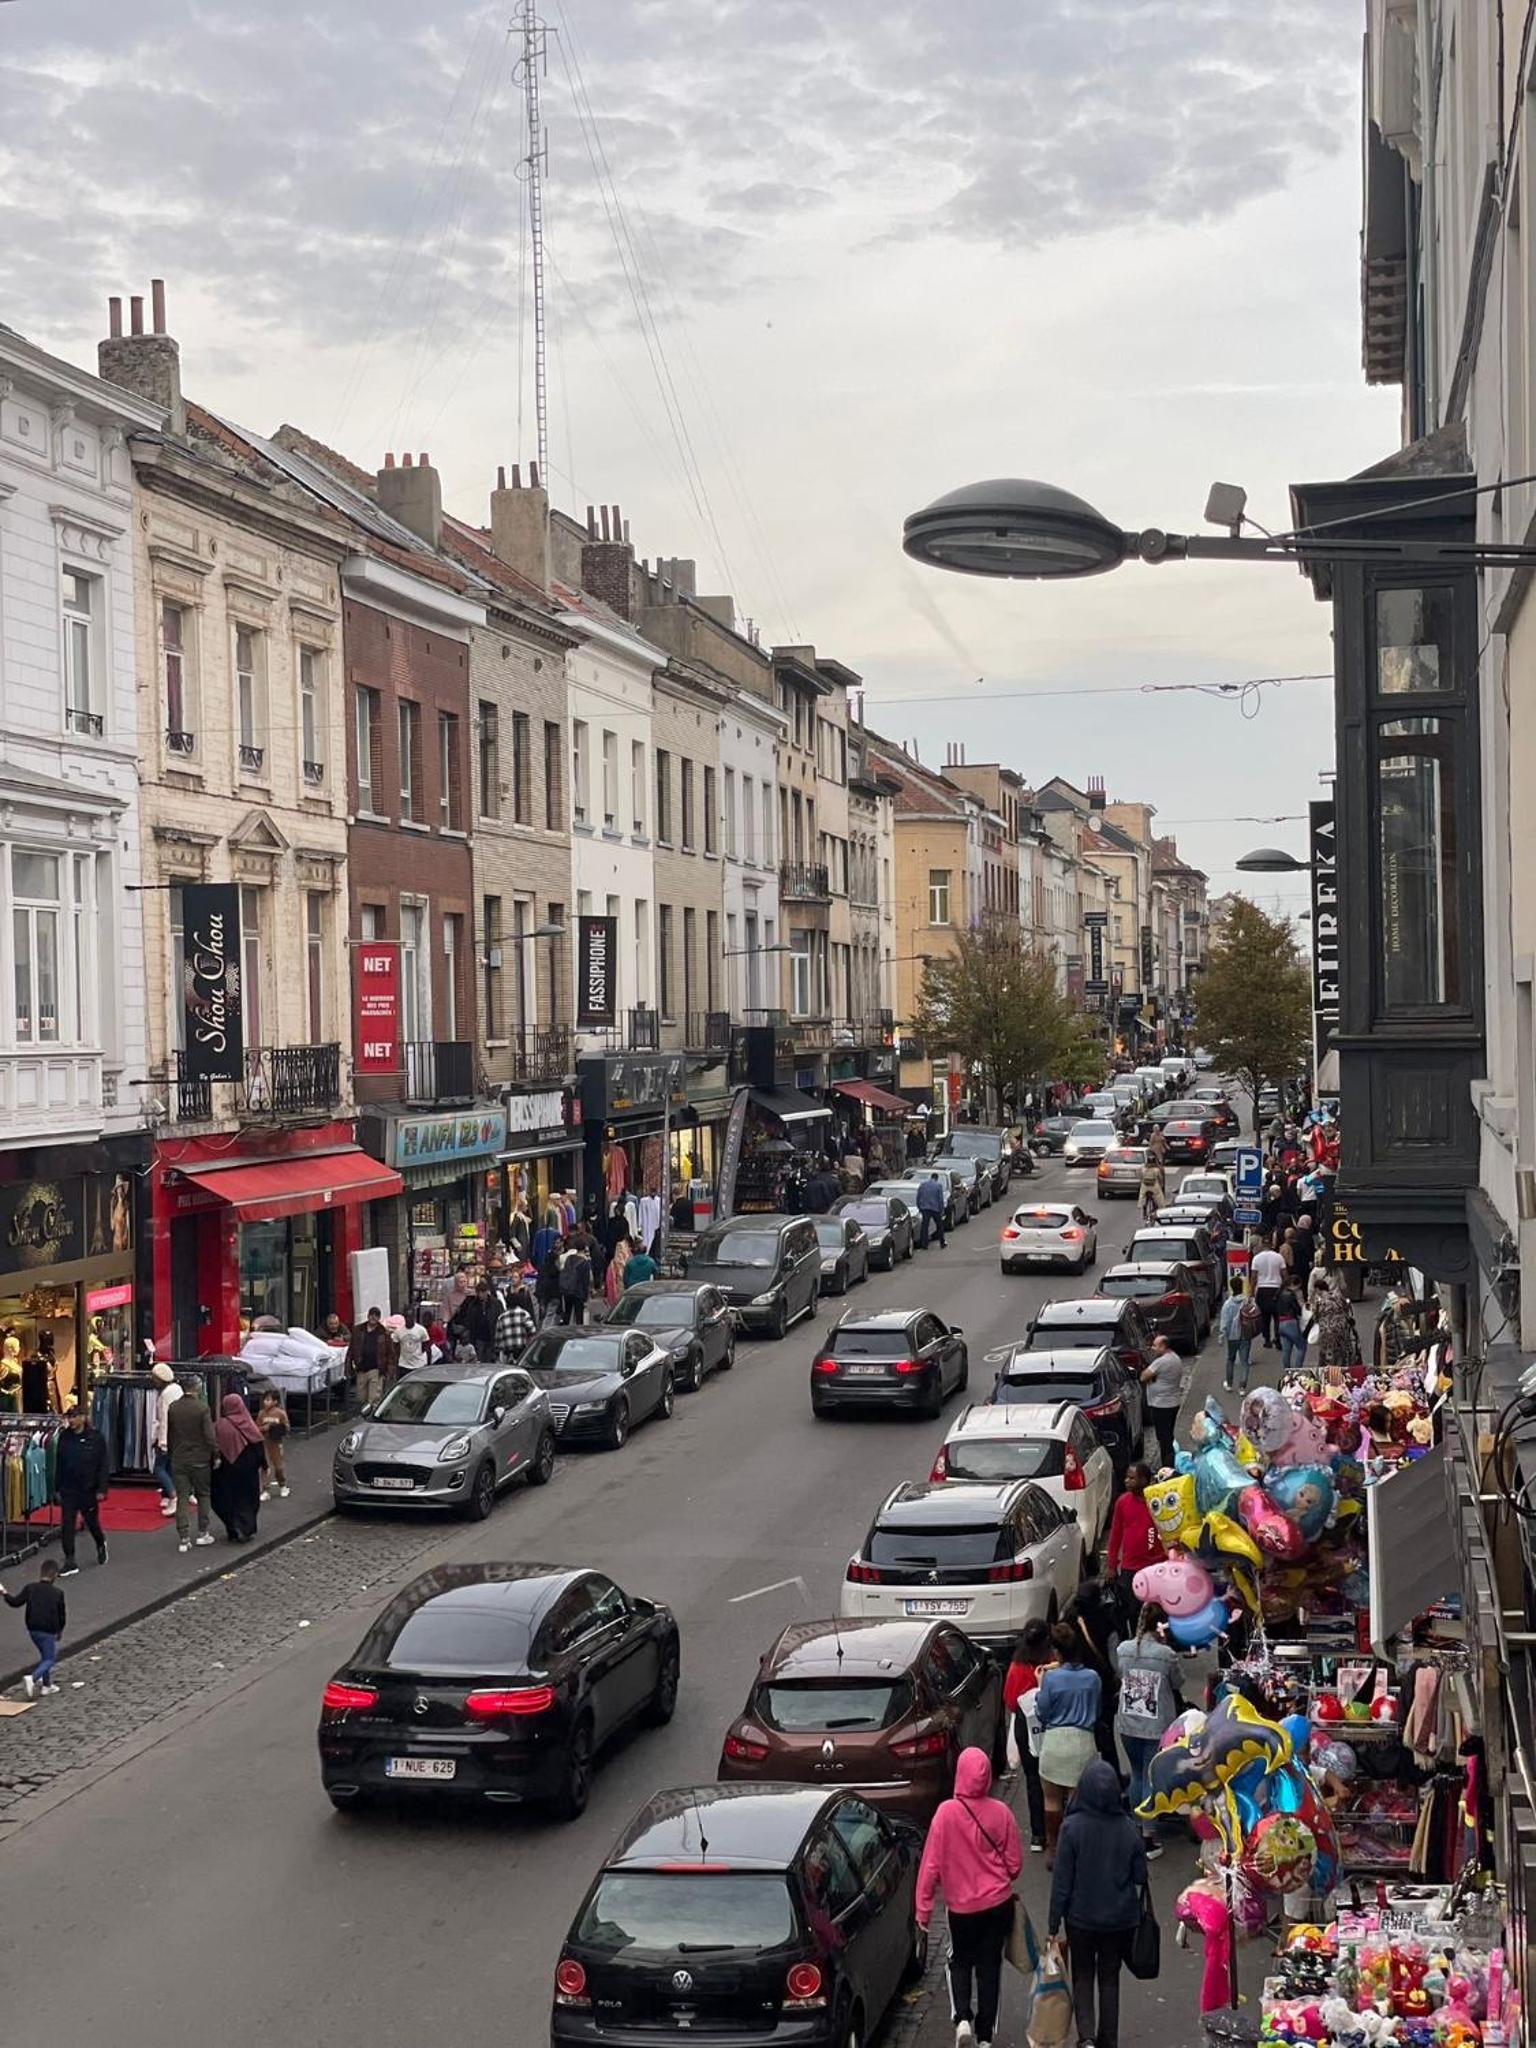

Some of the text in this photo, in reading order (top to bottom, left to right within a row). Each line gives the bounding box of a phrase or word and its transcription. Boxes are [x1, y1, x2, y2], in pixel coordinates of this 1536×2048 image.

[193, 912, 225, 980] Chou
[364, 957, 392, 972] NET
[589, 930, 606, 1011] FASSIPHONE
[195, 988, 227, 1053] Shou
[364, 1043, 392, 1058] NET
[1240, 1154, 1259, 1181] P
